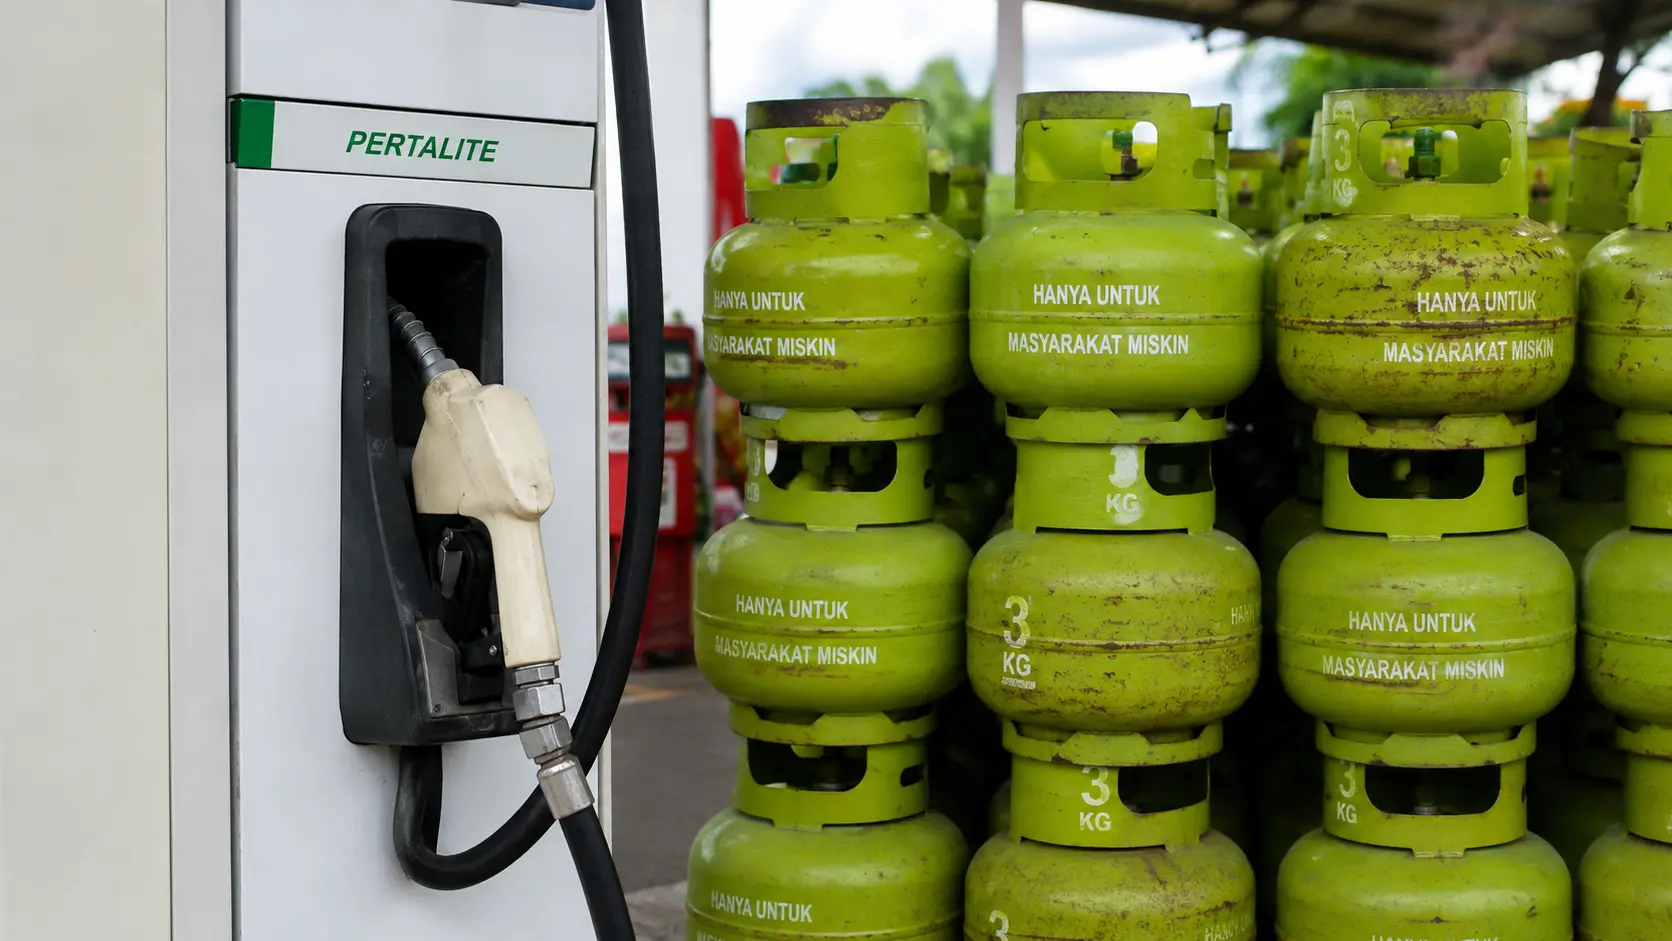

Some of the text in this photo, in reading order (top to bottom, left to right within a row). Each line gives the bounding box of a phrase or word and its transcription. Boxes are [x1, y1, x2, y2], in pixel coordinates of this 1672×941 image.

[345, 130, 500, 163] PERTALITE
[1334, 128, 1352, 172] 3
[713, 290, 806, 311] HANYA UNTUK
[1033, 284, 1161, 306] HANYA UNTUK
[1417, 290, 1537, 313] HANYA UNTUK
[707, 334, 836, 357] SYARAKAT MISKIN
[1008, 332, 1189, 355] MASYARAKAT MISKIN
[1383, 338, 1554, 363] MASYARAKAT MISKIN
[1106, 493, 1139, 514] KG
[735, 594, 849, 620] HANYA UNTUK
[1003, 595, 1030, 649] 3
[1349, 611, 1477, 633] HANYA UNTUK
[715, 635, 877, 665] MASYARAKAT MISKIN
[1003, 651, 1031, 677] KG
[1322, 655, 1505, 681] MASYARAKAT MISKIN
[1081, 766, 1110, 807] 3
[1079, 811, 1112, 832] KG
[1336, 801, 1358, 824] KG
[710, 890, 813, 923] HANYA UNTUK
